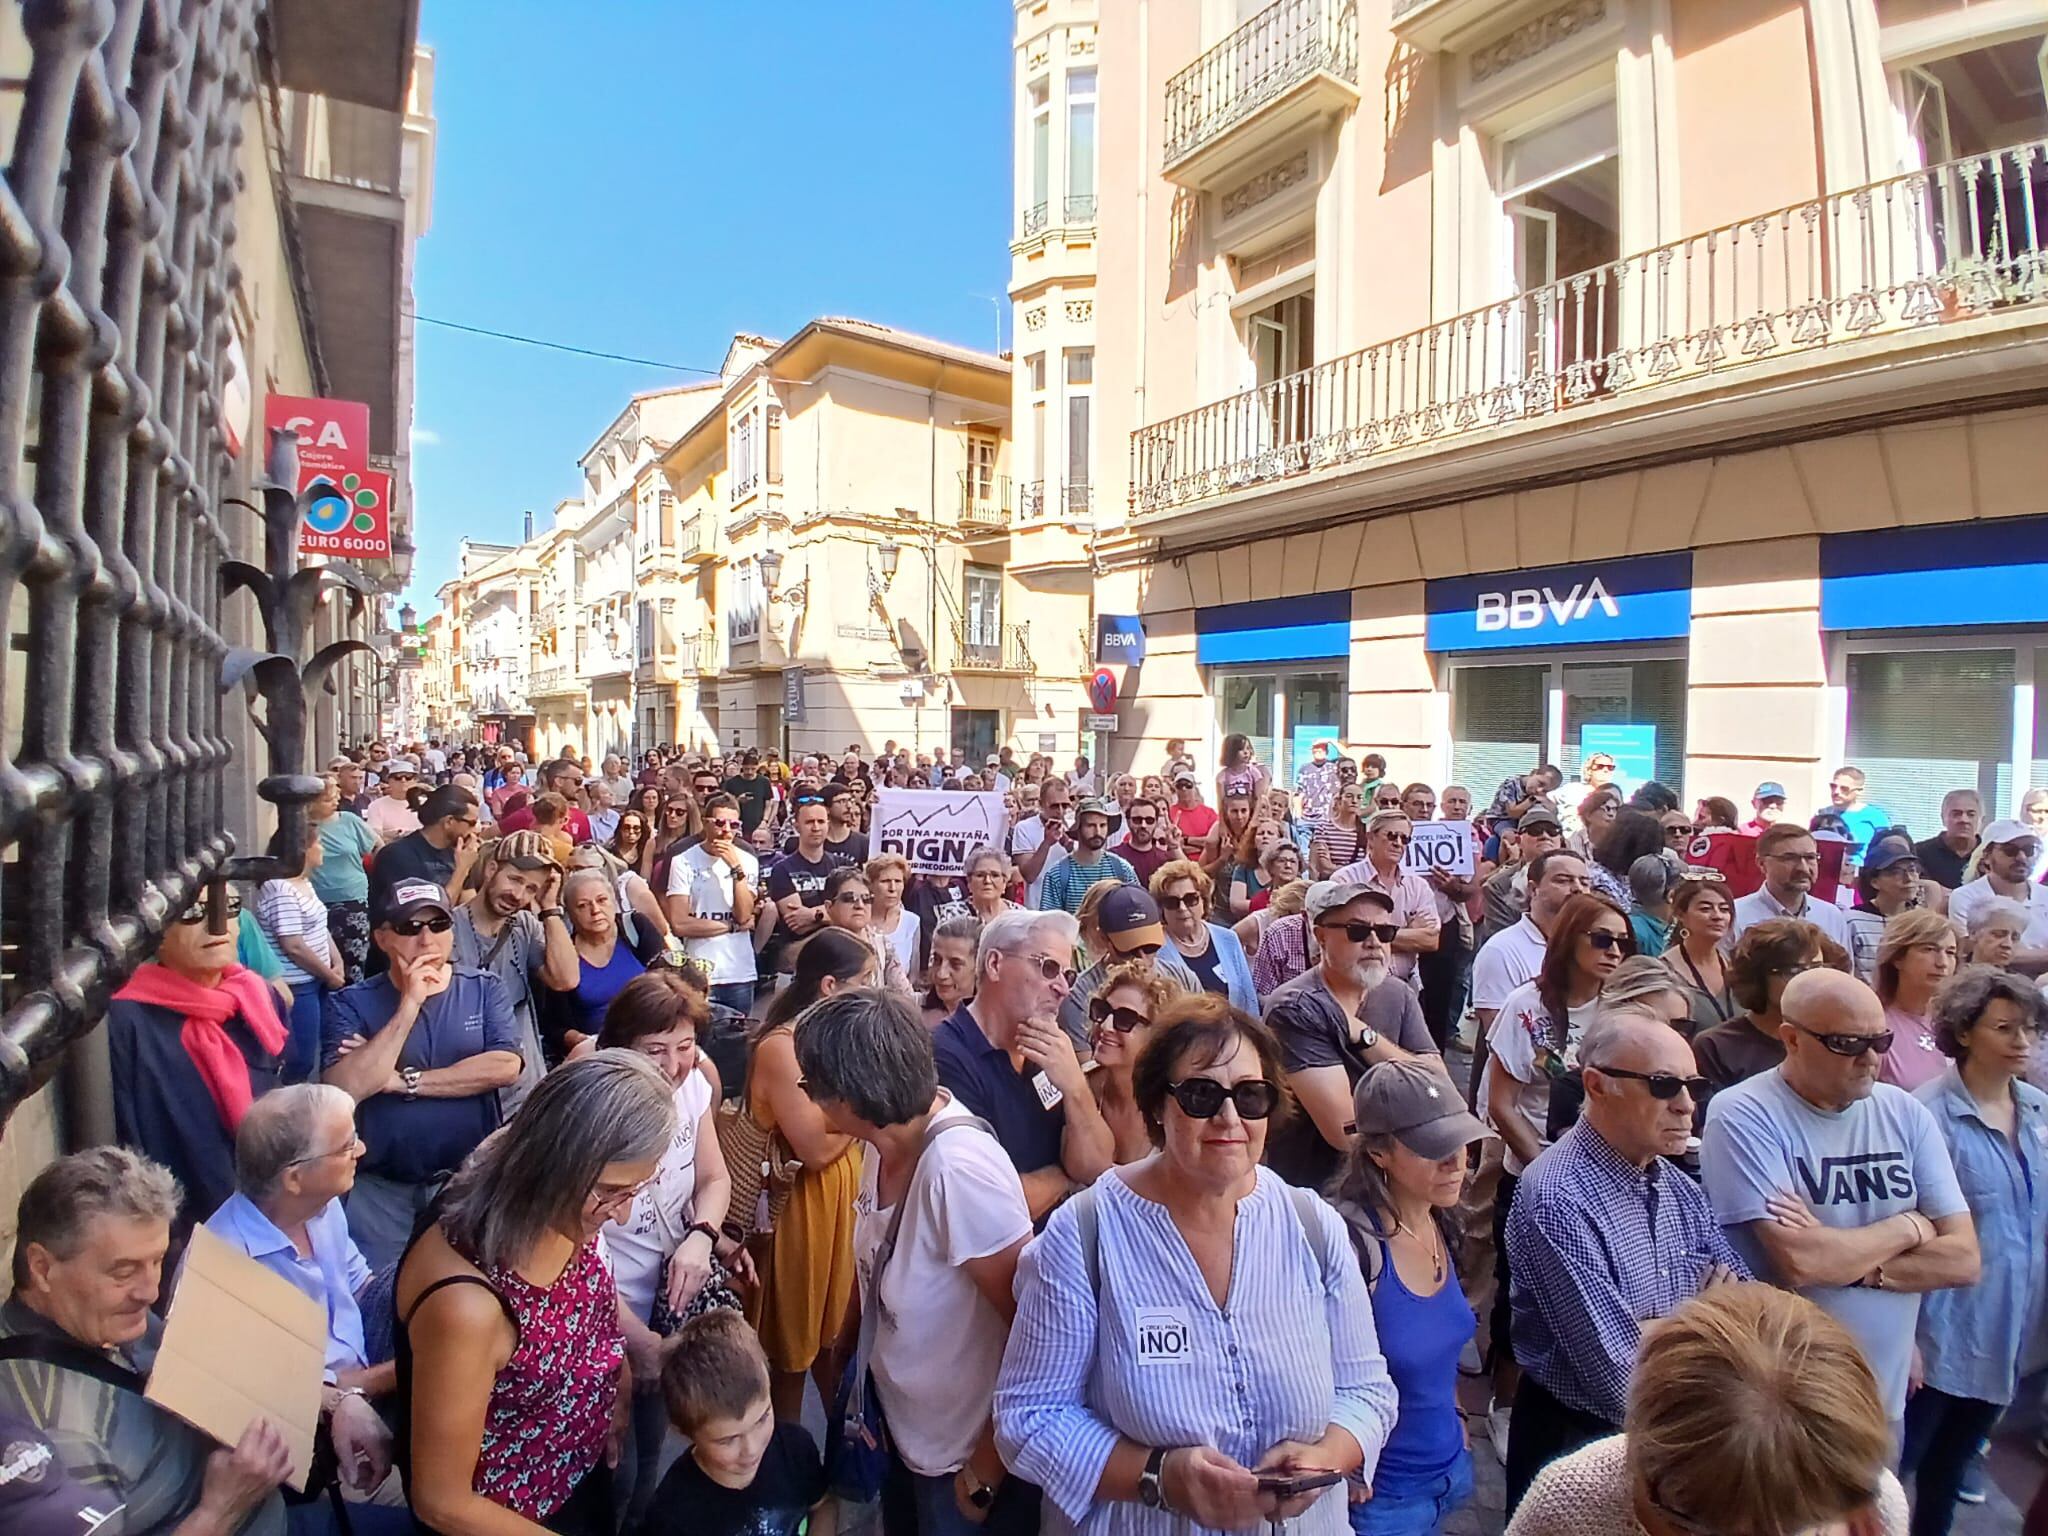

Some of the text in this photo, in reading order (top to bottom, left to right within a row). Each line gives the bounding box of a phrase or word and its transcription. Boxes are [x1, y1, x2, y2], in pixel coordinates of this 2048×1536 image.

[285, 416, 348, 450] CA
[298, 534, 386, 551] EURO 6000
[1475, 576, 1620, 632] BBVA
[1104, 632, 1136, 646] BBVA
[881, 828, 990, 841] POR UNA MONTAÑA
[1796, 1152, 1913, 1205] VANS
[1140, 1327, 1189, 1353] ¡NO!
